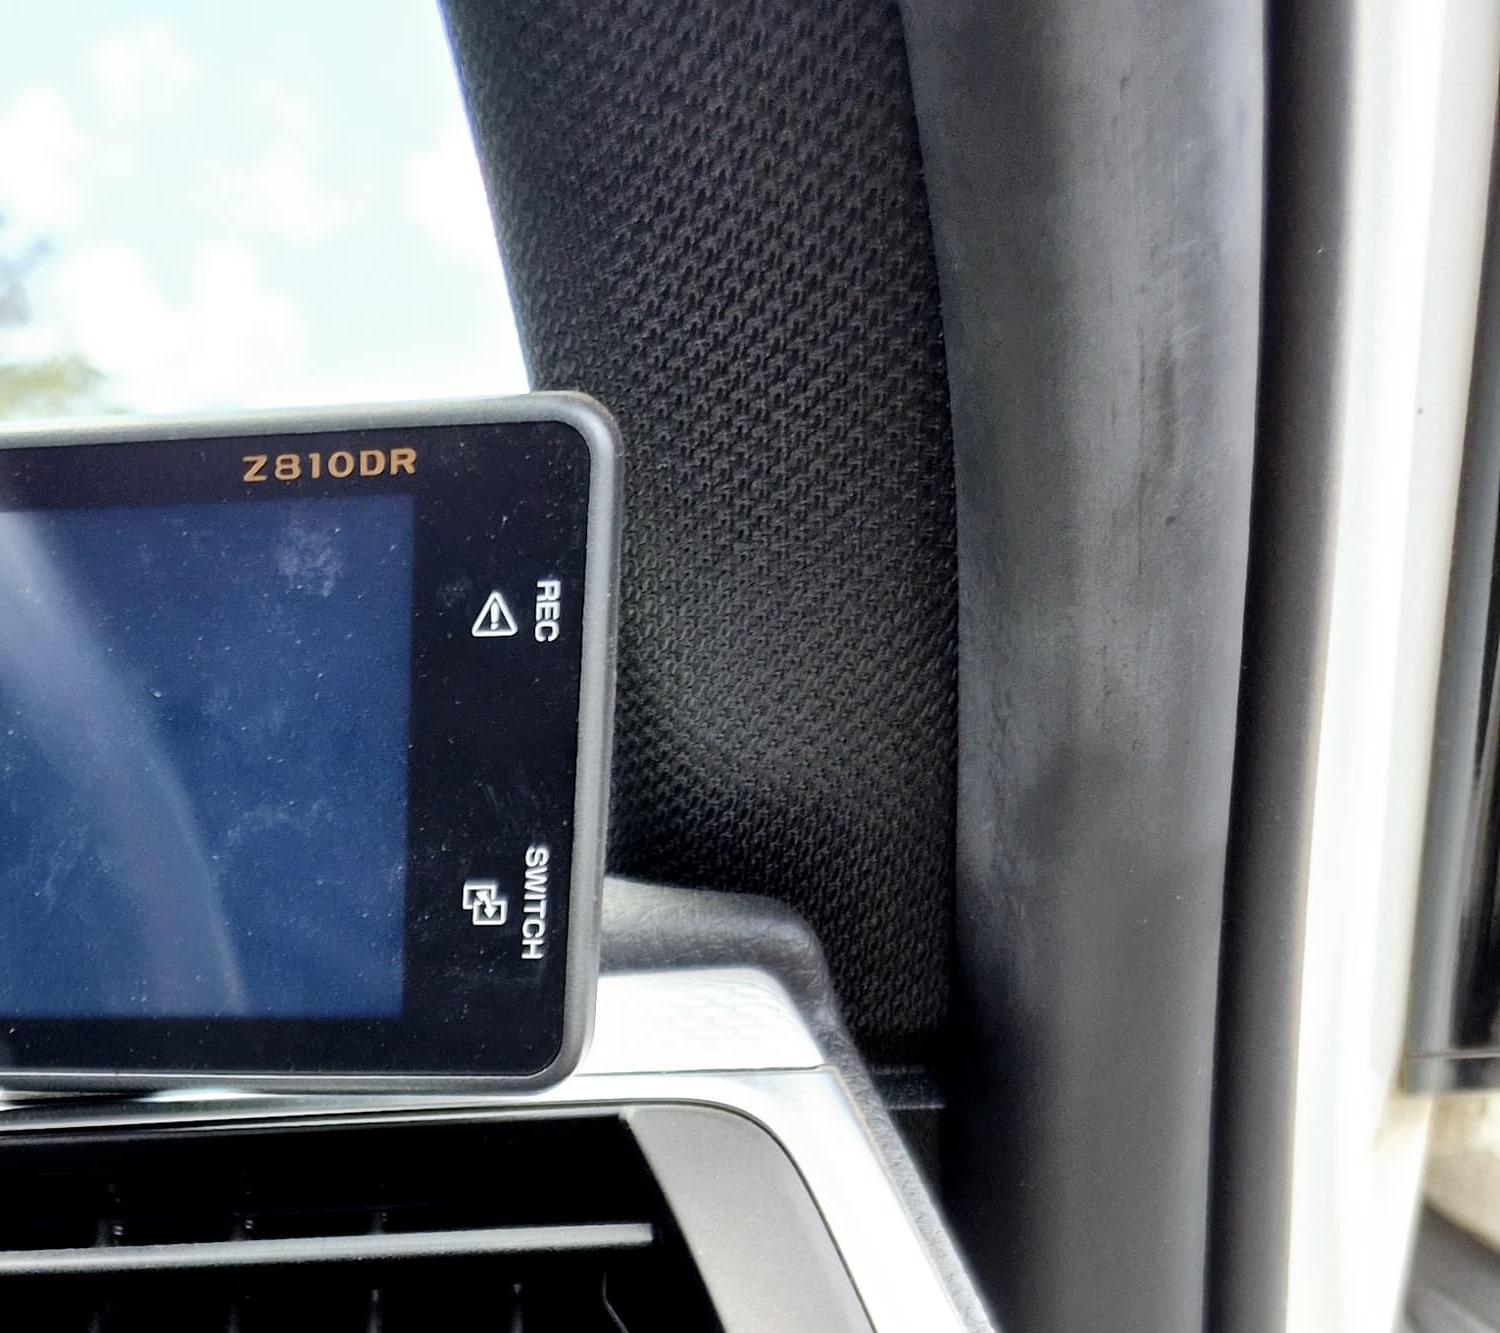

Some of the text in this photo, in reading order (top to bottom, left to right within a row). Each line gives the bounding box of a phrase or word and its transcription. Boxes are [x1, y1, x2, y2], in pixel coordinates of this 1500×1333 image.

[243, 448, 417, 482] Z810DR
[534, 579, 561, 642] REC
[521, 845, 549, 960] SWITCH
